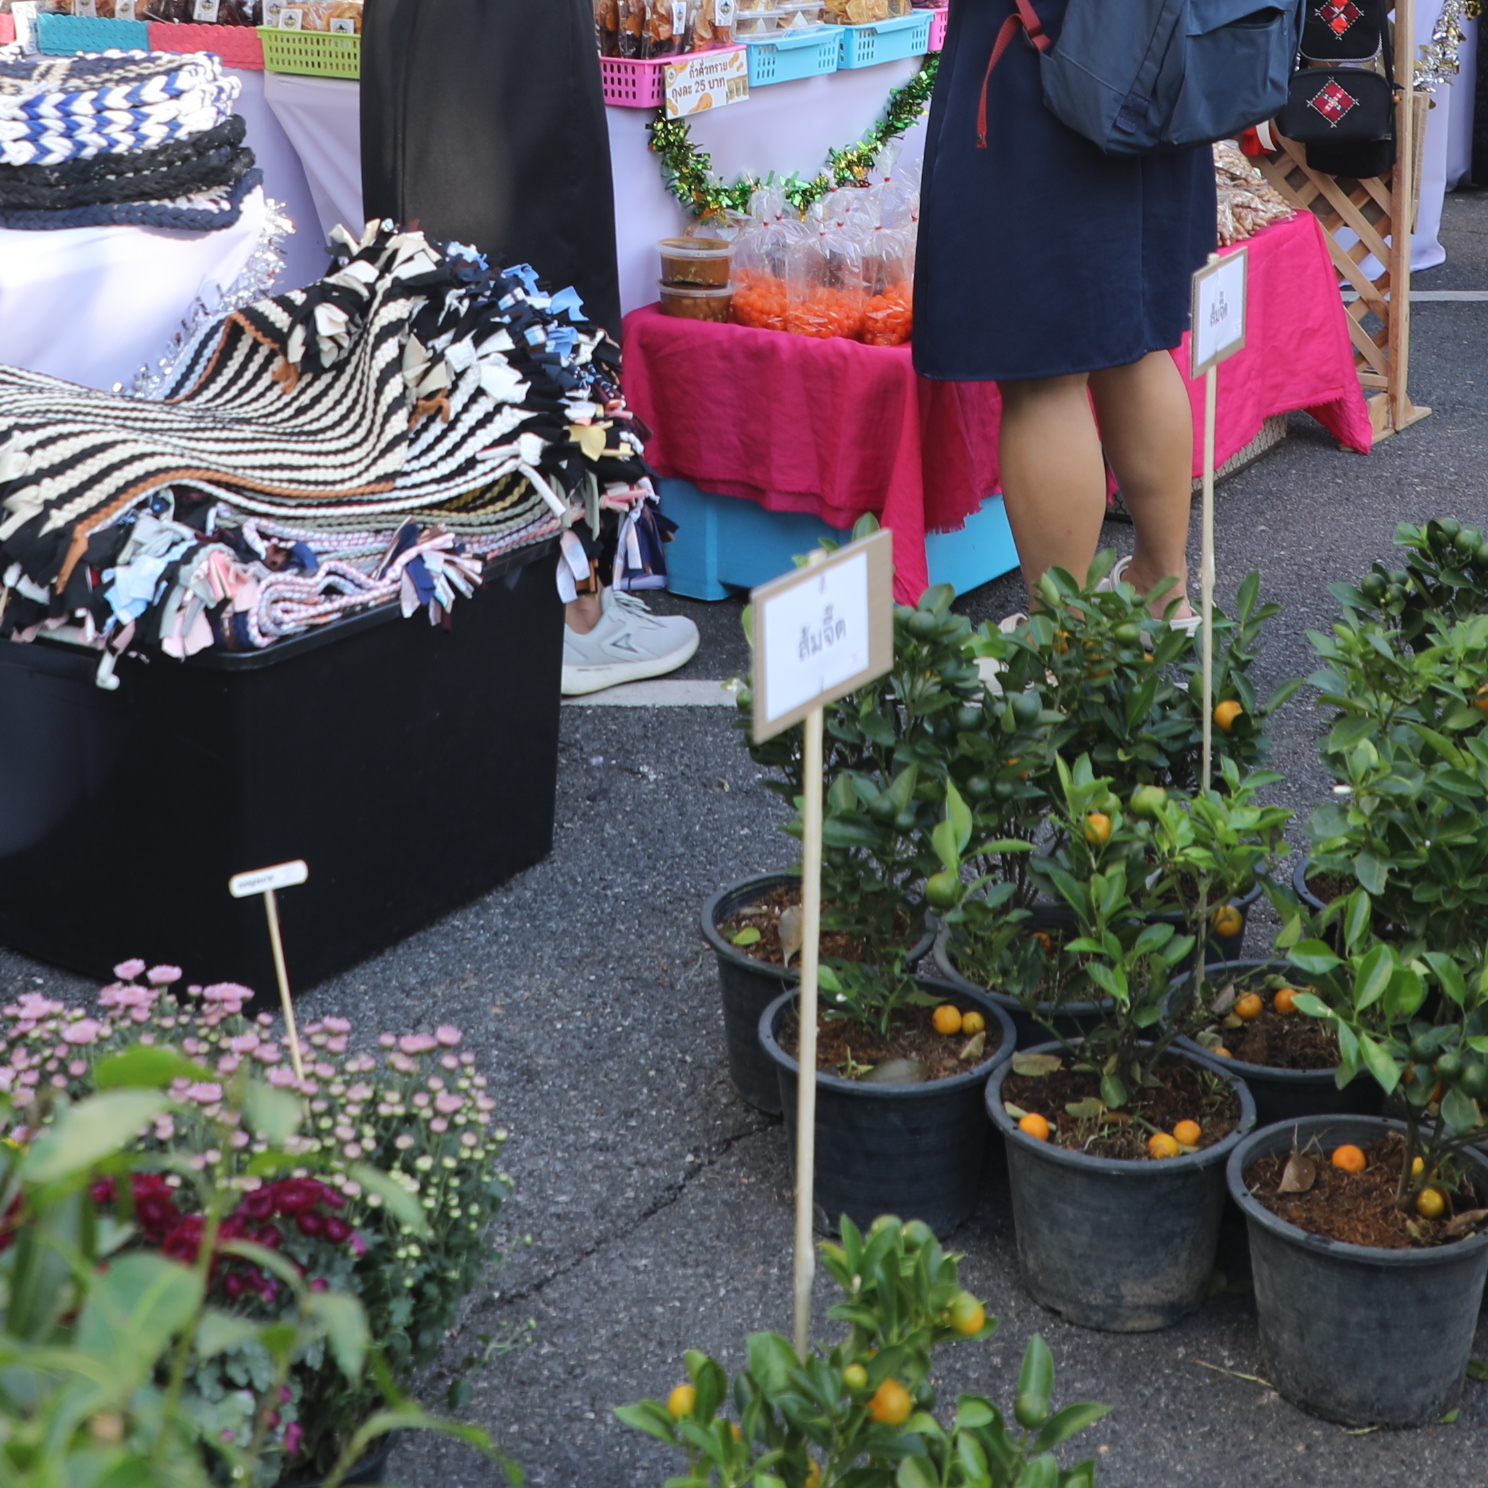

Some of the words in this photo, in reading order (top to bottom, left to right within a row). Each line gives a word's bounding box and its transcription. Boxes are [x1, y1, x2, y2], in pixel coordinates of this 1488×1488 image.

[689, 58, 728, 79] ถั่วคั่วทราย
[694, 79, 706, 93] 25
[708, 76, 726, 90] บาท
